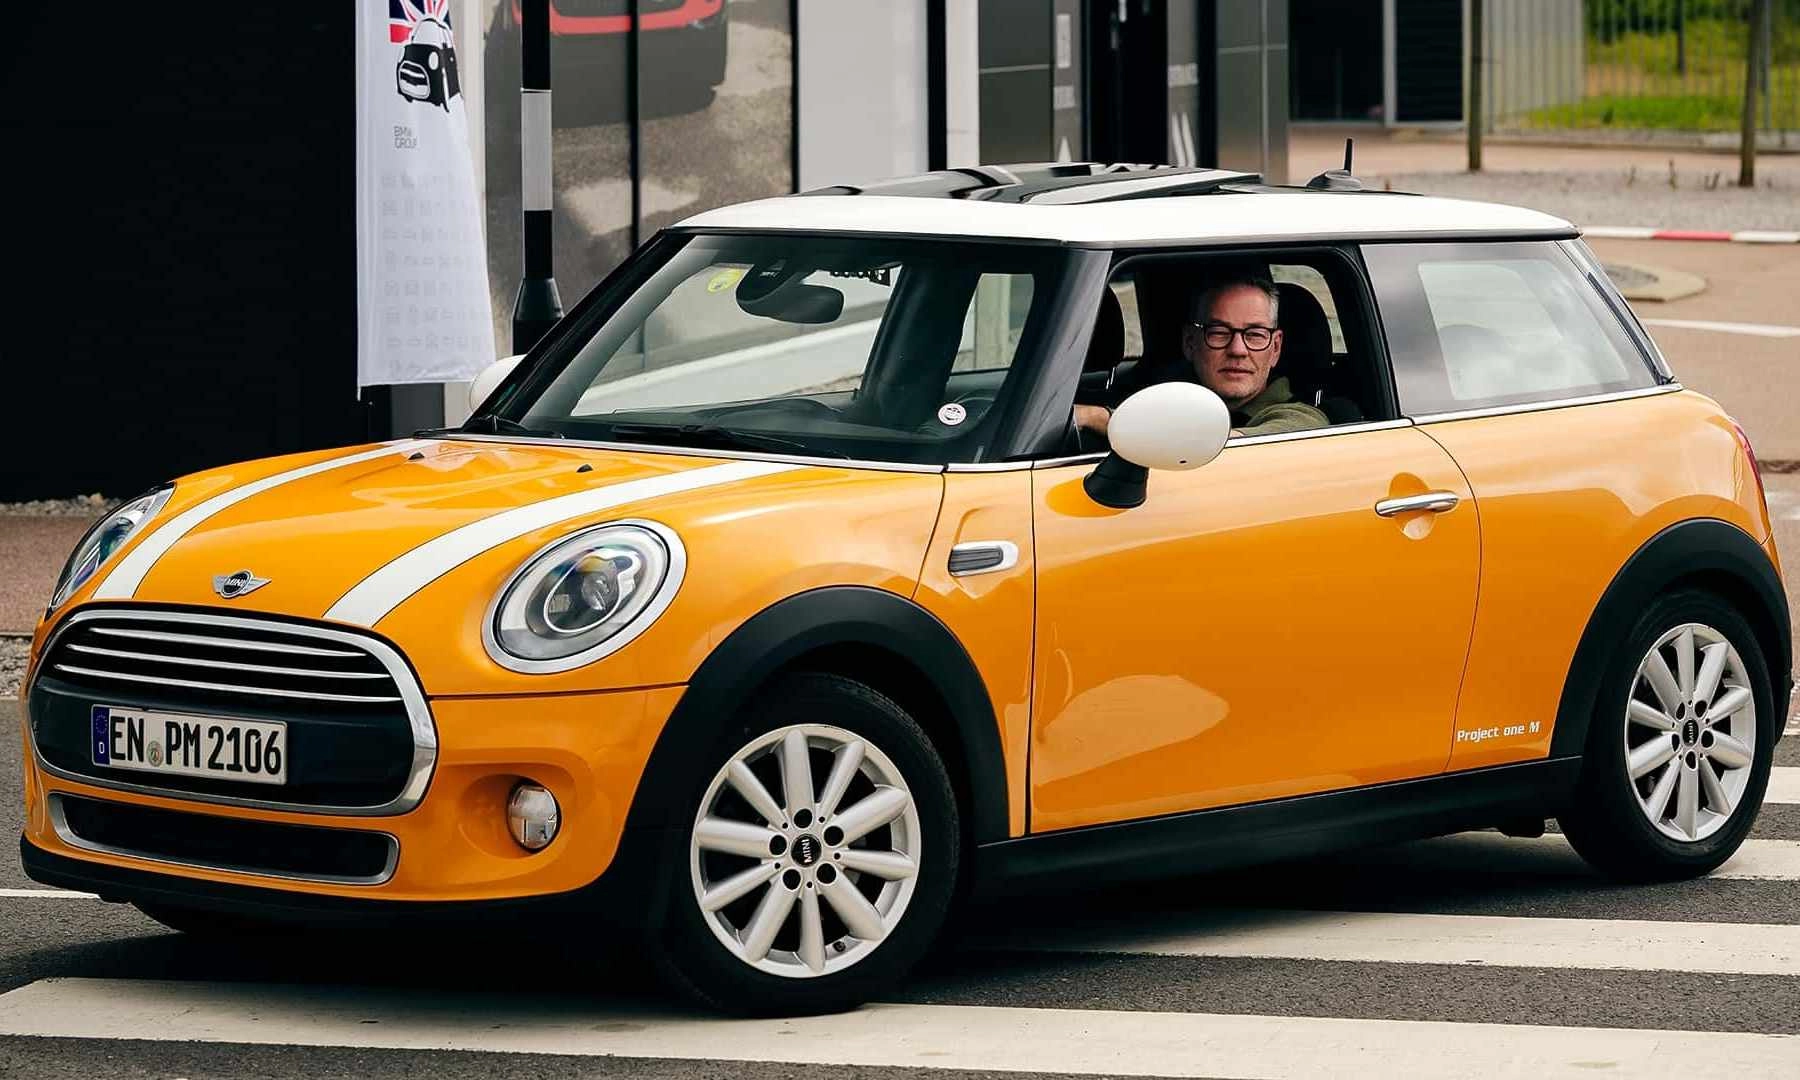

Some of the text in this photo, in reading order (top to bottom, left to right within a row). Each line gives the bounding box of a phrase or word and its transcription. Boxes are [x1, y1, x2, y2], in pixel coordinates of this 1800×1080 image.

[223, 576, 247, 588] MINI
[1456, 727, 1500, 743] Project
[1503, 724, 1526, 736] one
[98, 741, 106, 754] D
[109, 715, 282, 776] EN PM 2106
[801, 838, 813, 863] MINI
